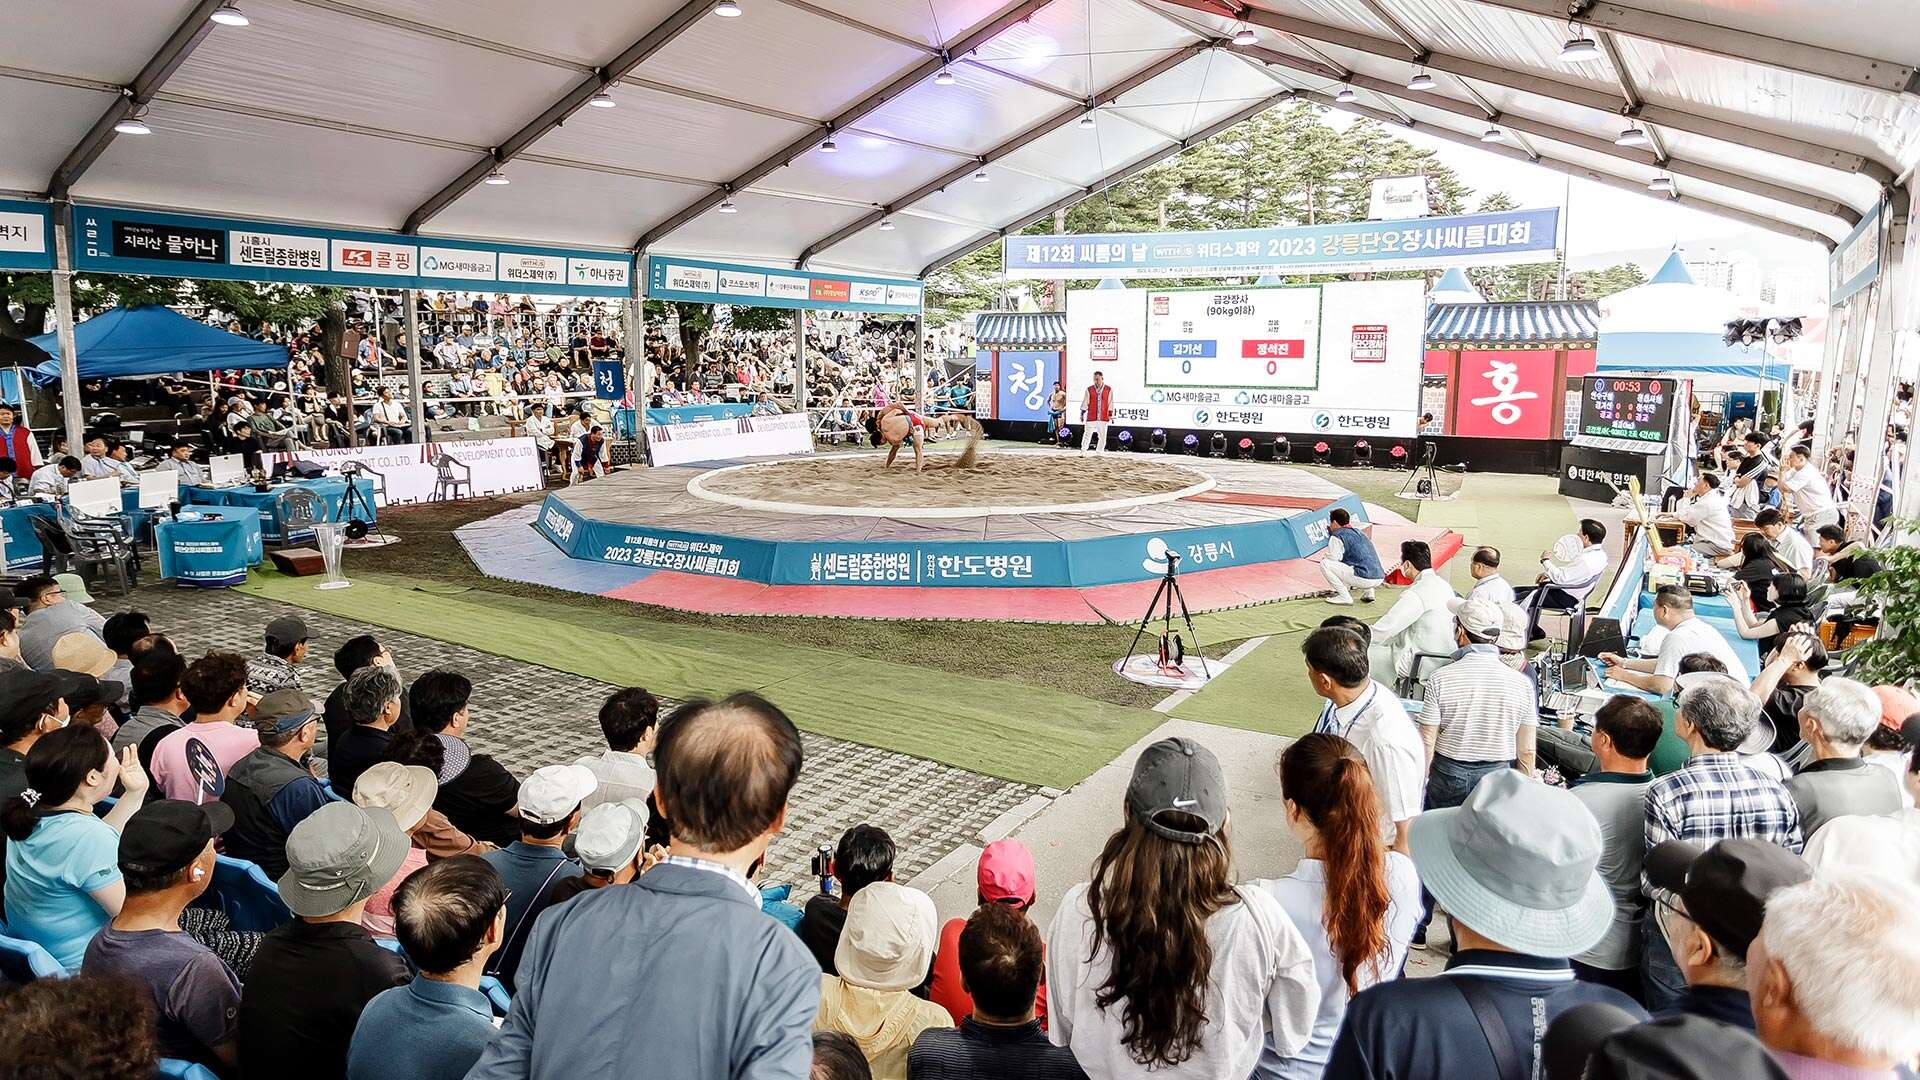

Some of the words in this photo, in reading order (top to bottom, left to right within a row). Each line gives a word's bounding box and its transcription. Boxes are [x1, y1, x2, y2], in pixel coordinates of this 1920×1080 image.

[124, 235, 162, 250] 지리산
[166, 235, 219, 255] 물하나
[240, 235, 271, 246] 시흥시
[1026, 244, 1075, 263] 제12회
[1080, 243, 1126, 263] 씨름의
[1131, 243, 1148, 262] 날
[1197, 240, 1260, 258] 위더스제약
[1268, 236, 1316, 257] 2023
[1321, 221, 1531, 255] 강릉단오장사씨름대회
[239, 246, 321, 268] 센트럴종합병원
[376, 251, 410, 269] 콜핑
[507, 267, 557, 281] 위더스제약(주)
[590, 268, 624, 281] 하나증권
[1213, 295, 1249, 305] 금강장사
[1206, 305, 1255, 316] (90kg이하)
[1257, 343, 1289, 355] 정석진
[1182, 360, 1191, 374] 0
[1266, 360, 1277, 375] 0
[599, 369, 614, 393] 청
[1008, 359, 1045, 411] 청
[1613, 381, 1640, 392] 00:53
[1471, 359, 1538, 424] 홍
[1216, 411, 1263, 424] 한도병원
[1338, 415, 1390, 429] 한도병원
[453, 449, 503, 462] DEVELOPMENT
[690, 542, 723, 555] 위더스제약
[1187, 541, 1235, 564] 강릉시
[604, 546, 631, 562] 2023
[633, 548, 740, 577] 강릉단오장사씨름대회
[810, 552, 822, 581] 시흥시
[823, 552, 910, 581] 센트럴종합병원
[937, 554, 1032, 578] 한도병원
[1534, 1028, 1541, 1042] TO
